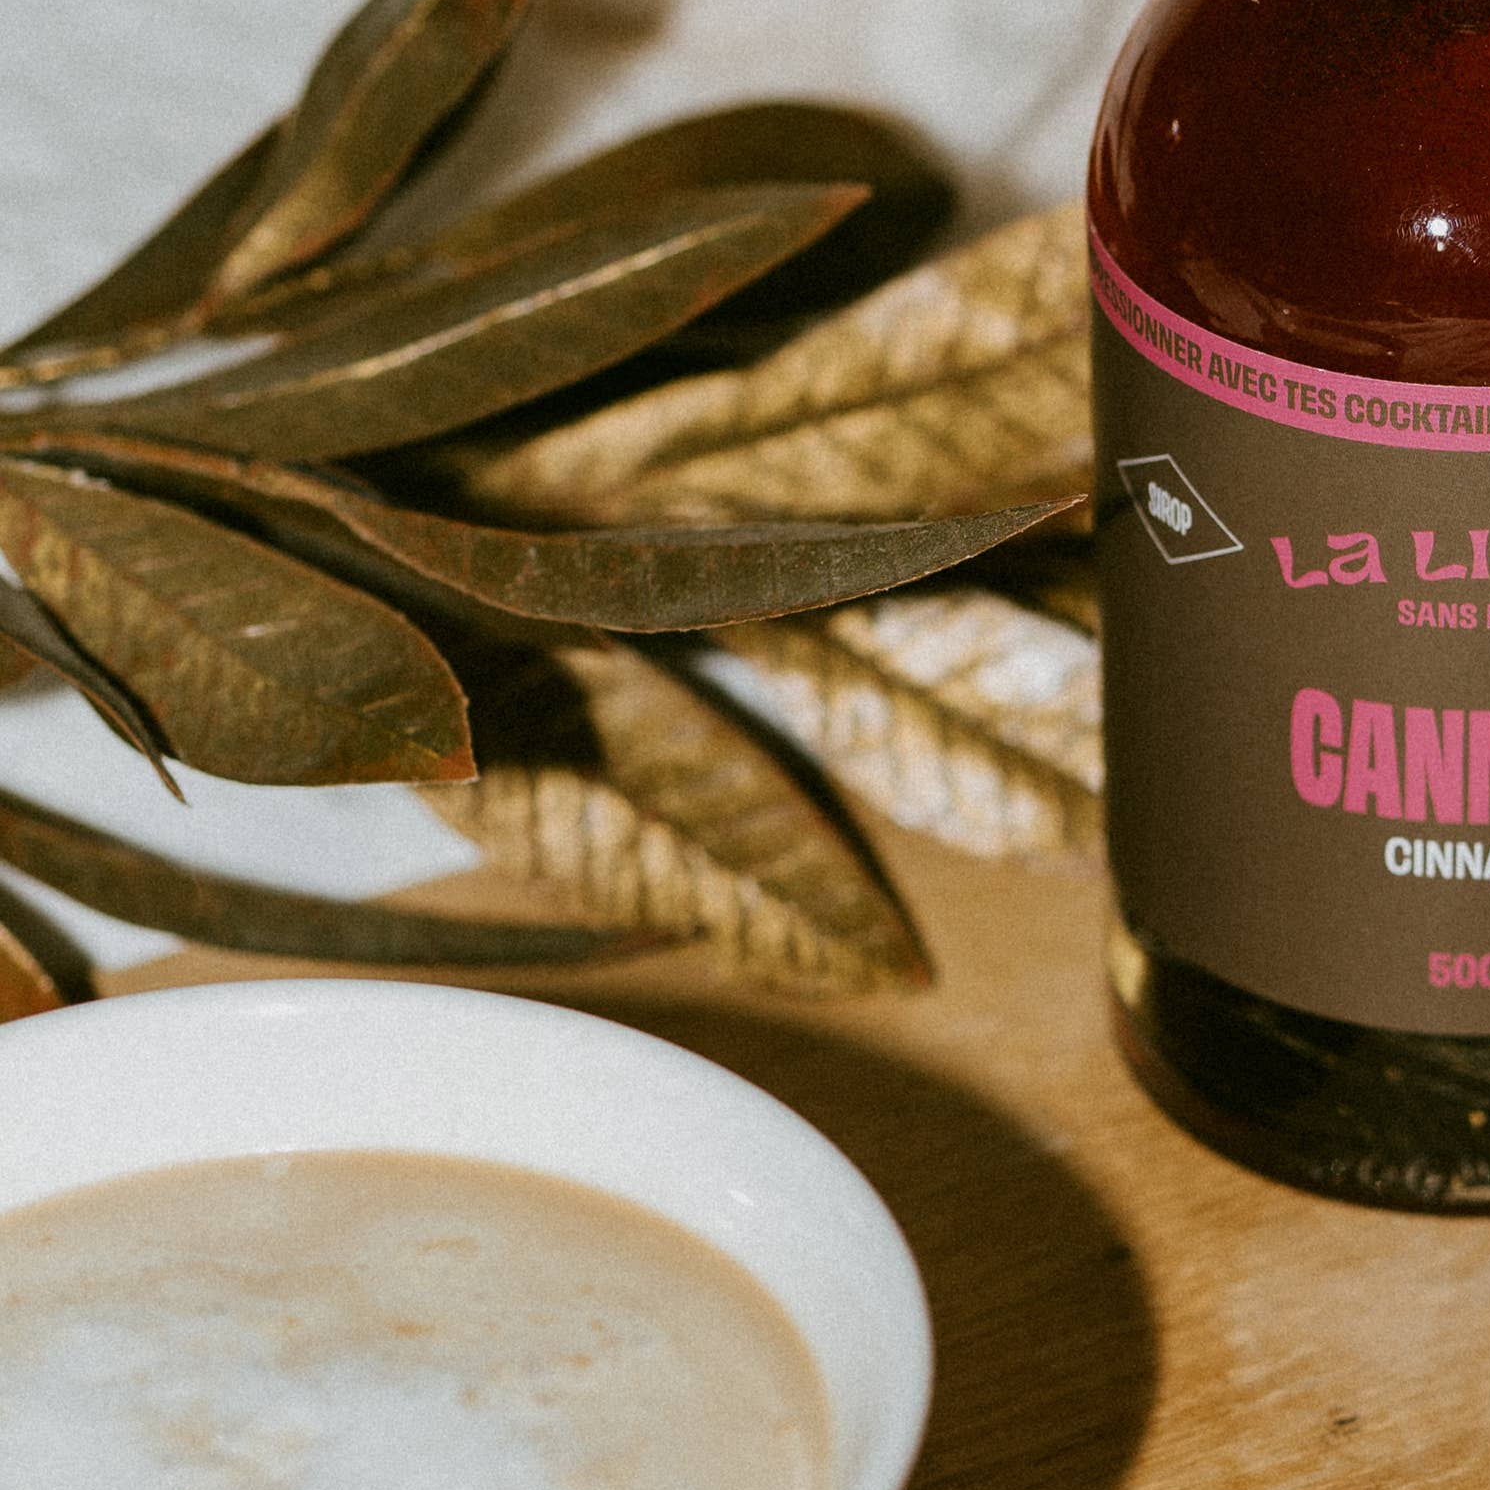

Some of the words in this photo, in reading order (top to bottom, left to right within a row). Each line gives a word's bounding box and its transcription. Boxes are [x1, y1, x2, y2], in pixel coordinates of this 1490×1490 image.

[1208, 351, 1276, 402] AVEC
[1283, 378, 1337, 420] TES
[1148, 481, 1192, 536] SIROP
[1397, 599, 1477, 629] SANS
